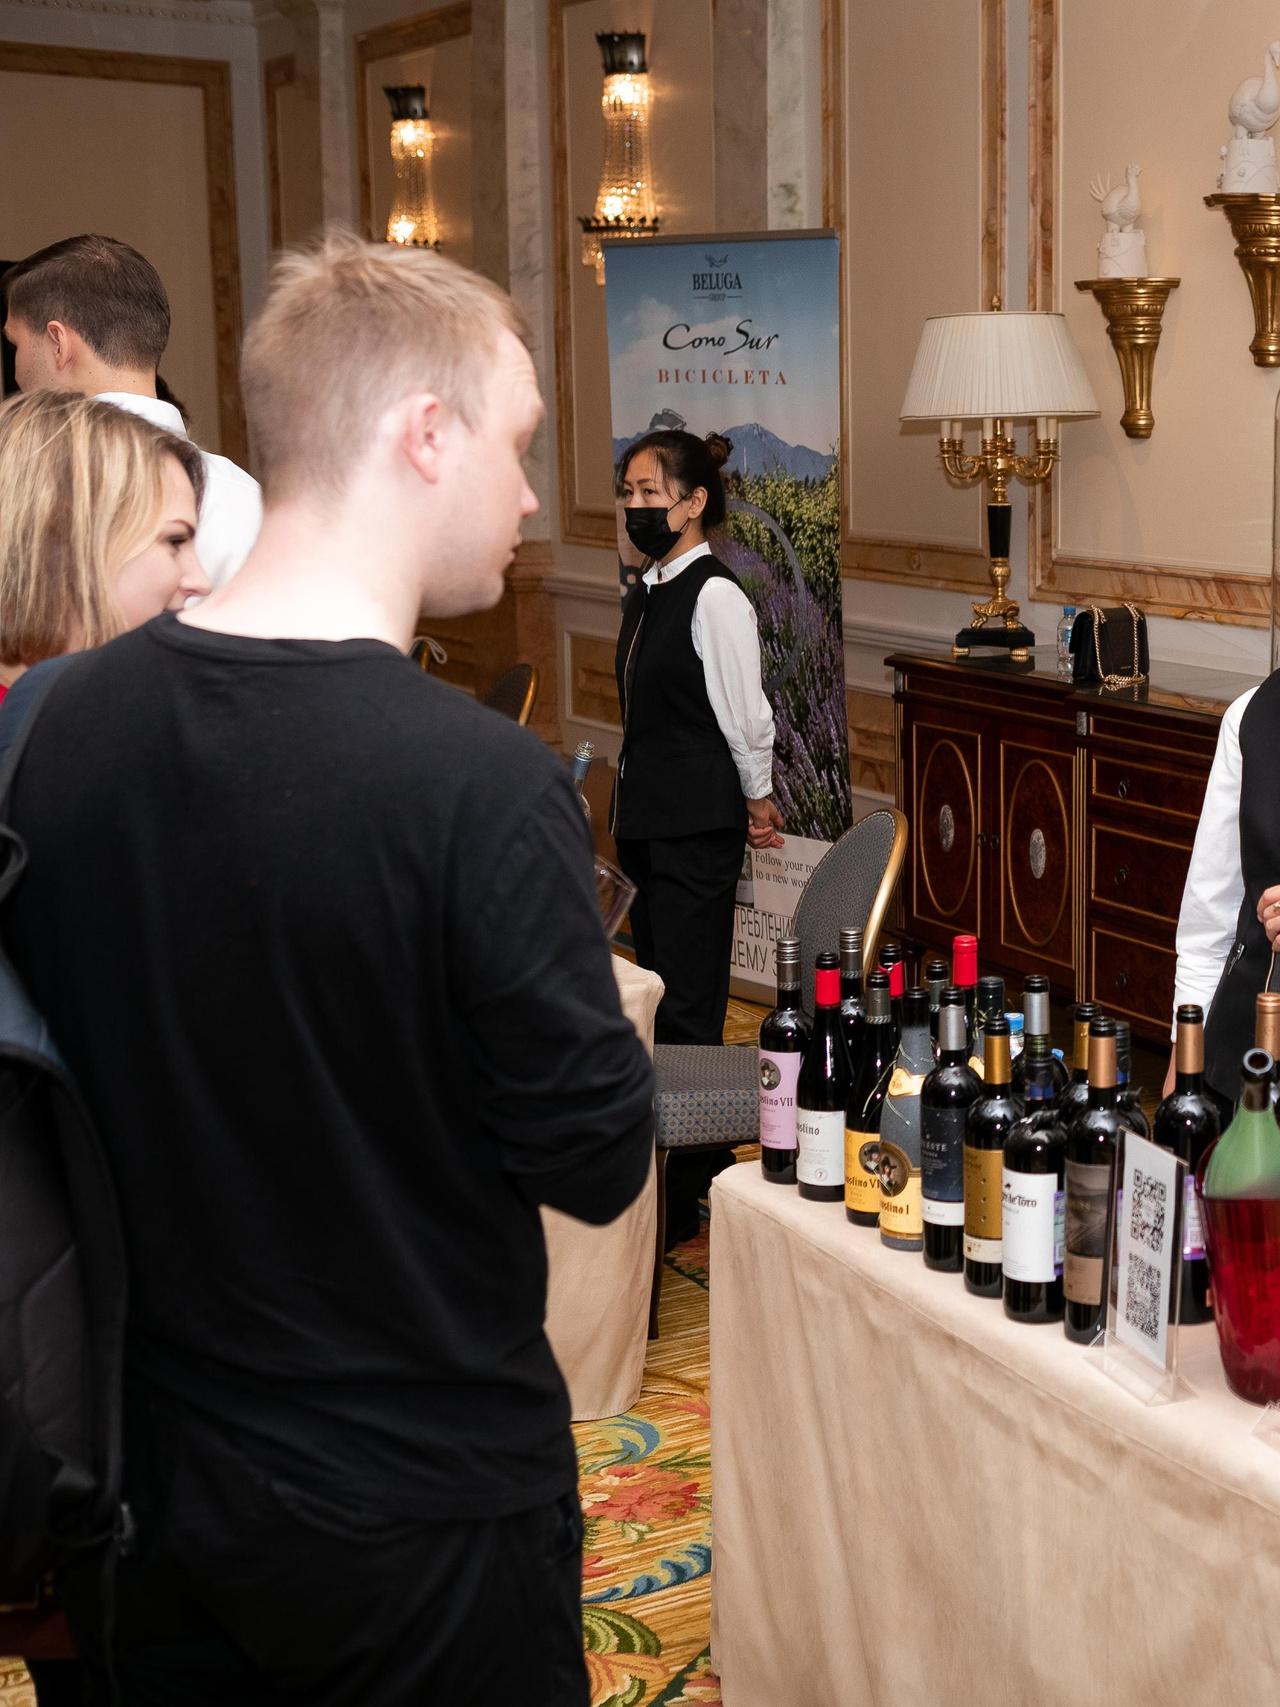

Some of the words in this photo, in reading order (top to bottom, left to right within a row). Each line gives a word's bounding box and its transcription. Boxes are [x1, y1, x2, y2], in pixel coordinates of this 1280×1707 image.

[692, 273, 742, 290] BELUGA
[662, 323, 725, 351] Cono
[723, 319, 779, 356] Sur
[658, 369, 787, 386] BICICLETA
[755, 851, 783, 867] Follow
[784, 860, 804, 872] your
[805, 864, 814, 874] ro
[755, 869, 763, 880] to
[765, 872, 770, 881] a
[772, 874, 788, 885] new
[791, 877, 808, 889] wor
[735, 906, 793, 942] ТРЕБЛЕНИ
[780, 1097, 793, 1107] VII
[869, 1179, 880, 1189] VI
